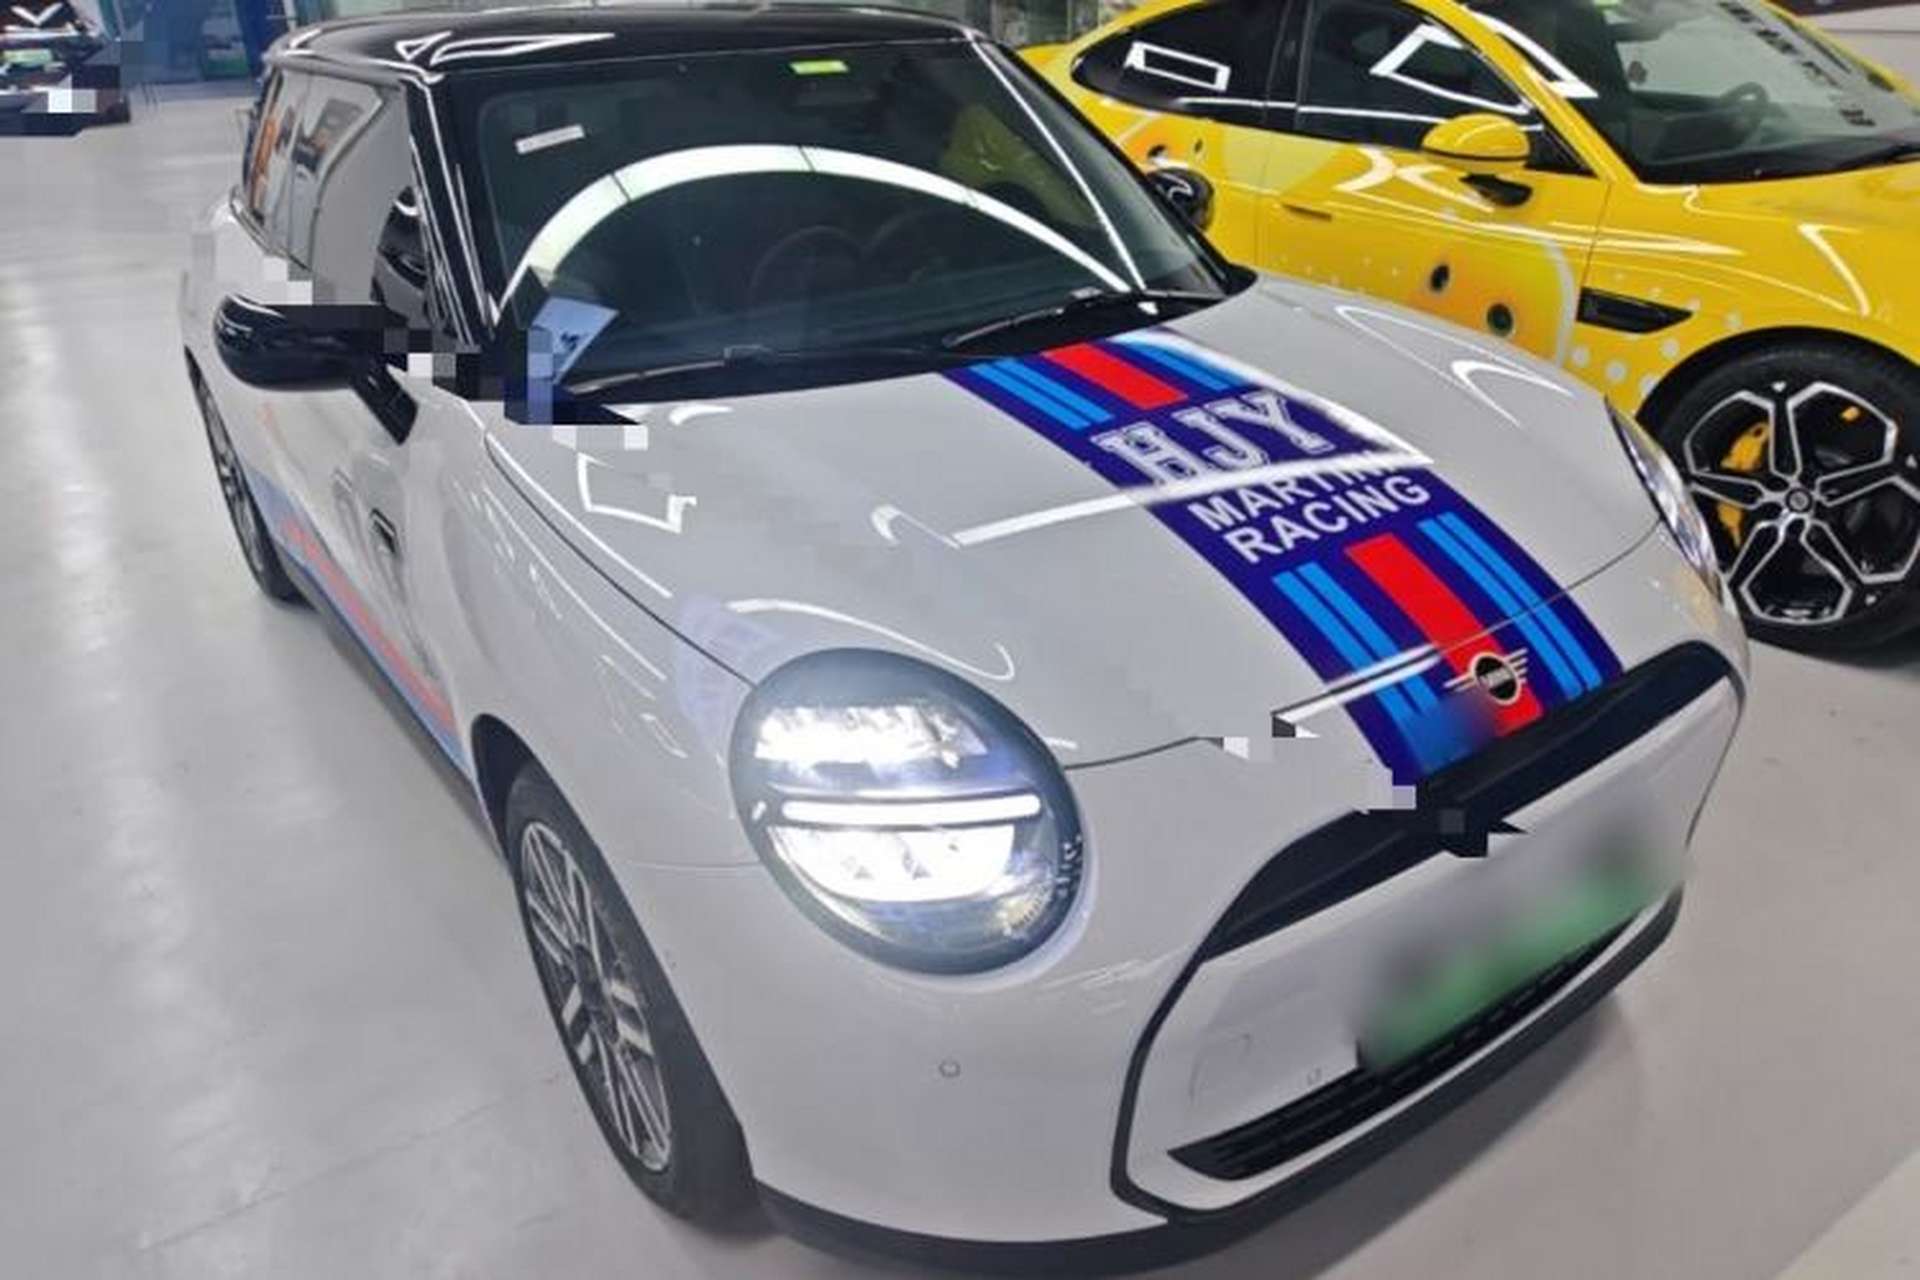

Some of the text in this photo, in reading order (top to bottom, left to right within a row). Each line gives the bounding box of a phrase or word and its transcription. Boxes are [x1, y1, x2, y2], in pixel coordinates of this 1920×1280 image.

[1090, 388, 1336, 487] HJY
[1187, 450, 1396, 532] MARTIN
[1223, 475, 1431, 563] RACING
